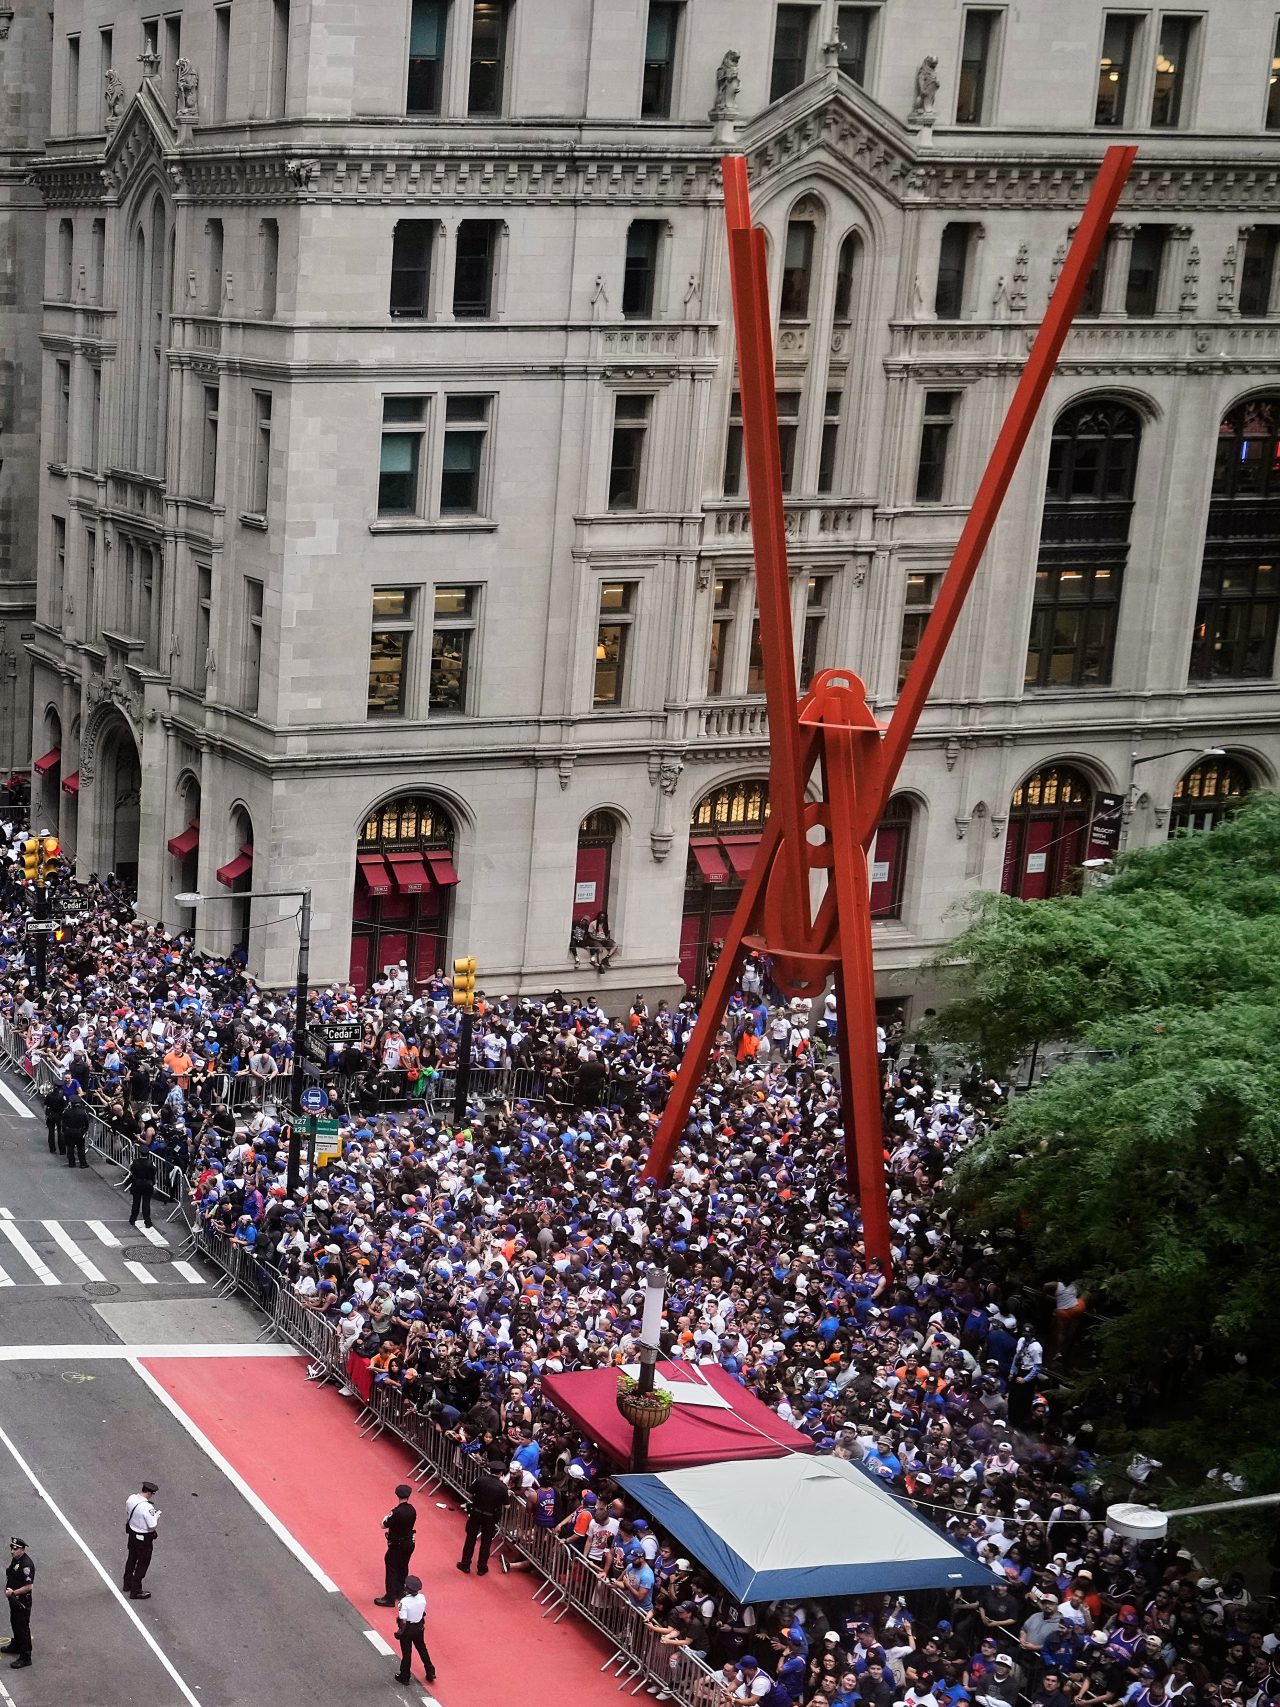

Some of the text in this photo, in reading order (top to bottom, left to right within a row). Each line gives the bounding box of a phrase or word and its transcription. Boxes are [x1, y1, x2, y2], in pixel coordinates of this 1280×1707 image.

[63, 901, 81, 909] Cedar
[328, 1029, 353, 1039] Cedar
[544, 1505, 554, 1516] 7
